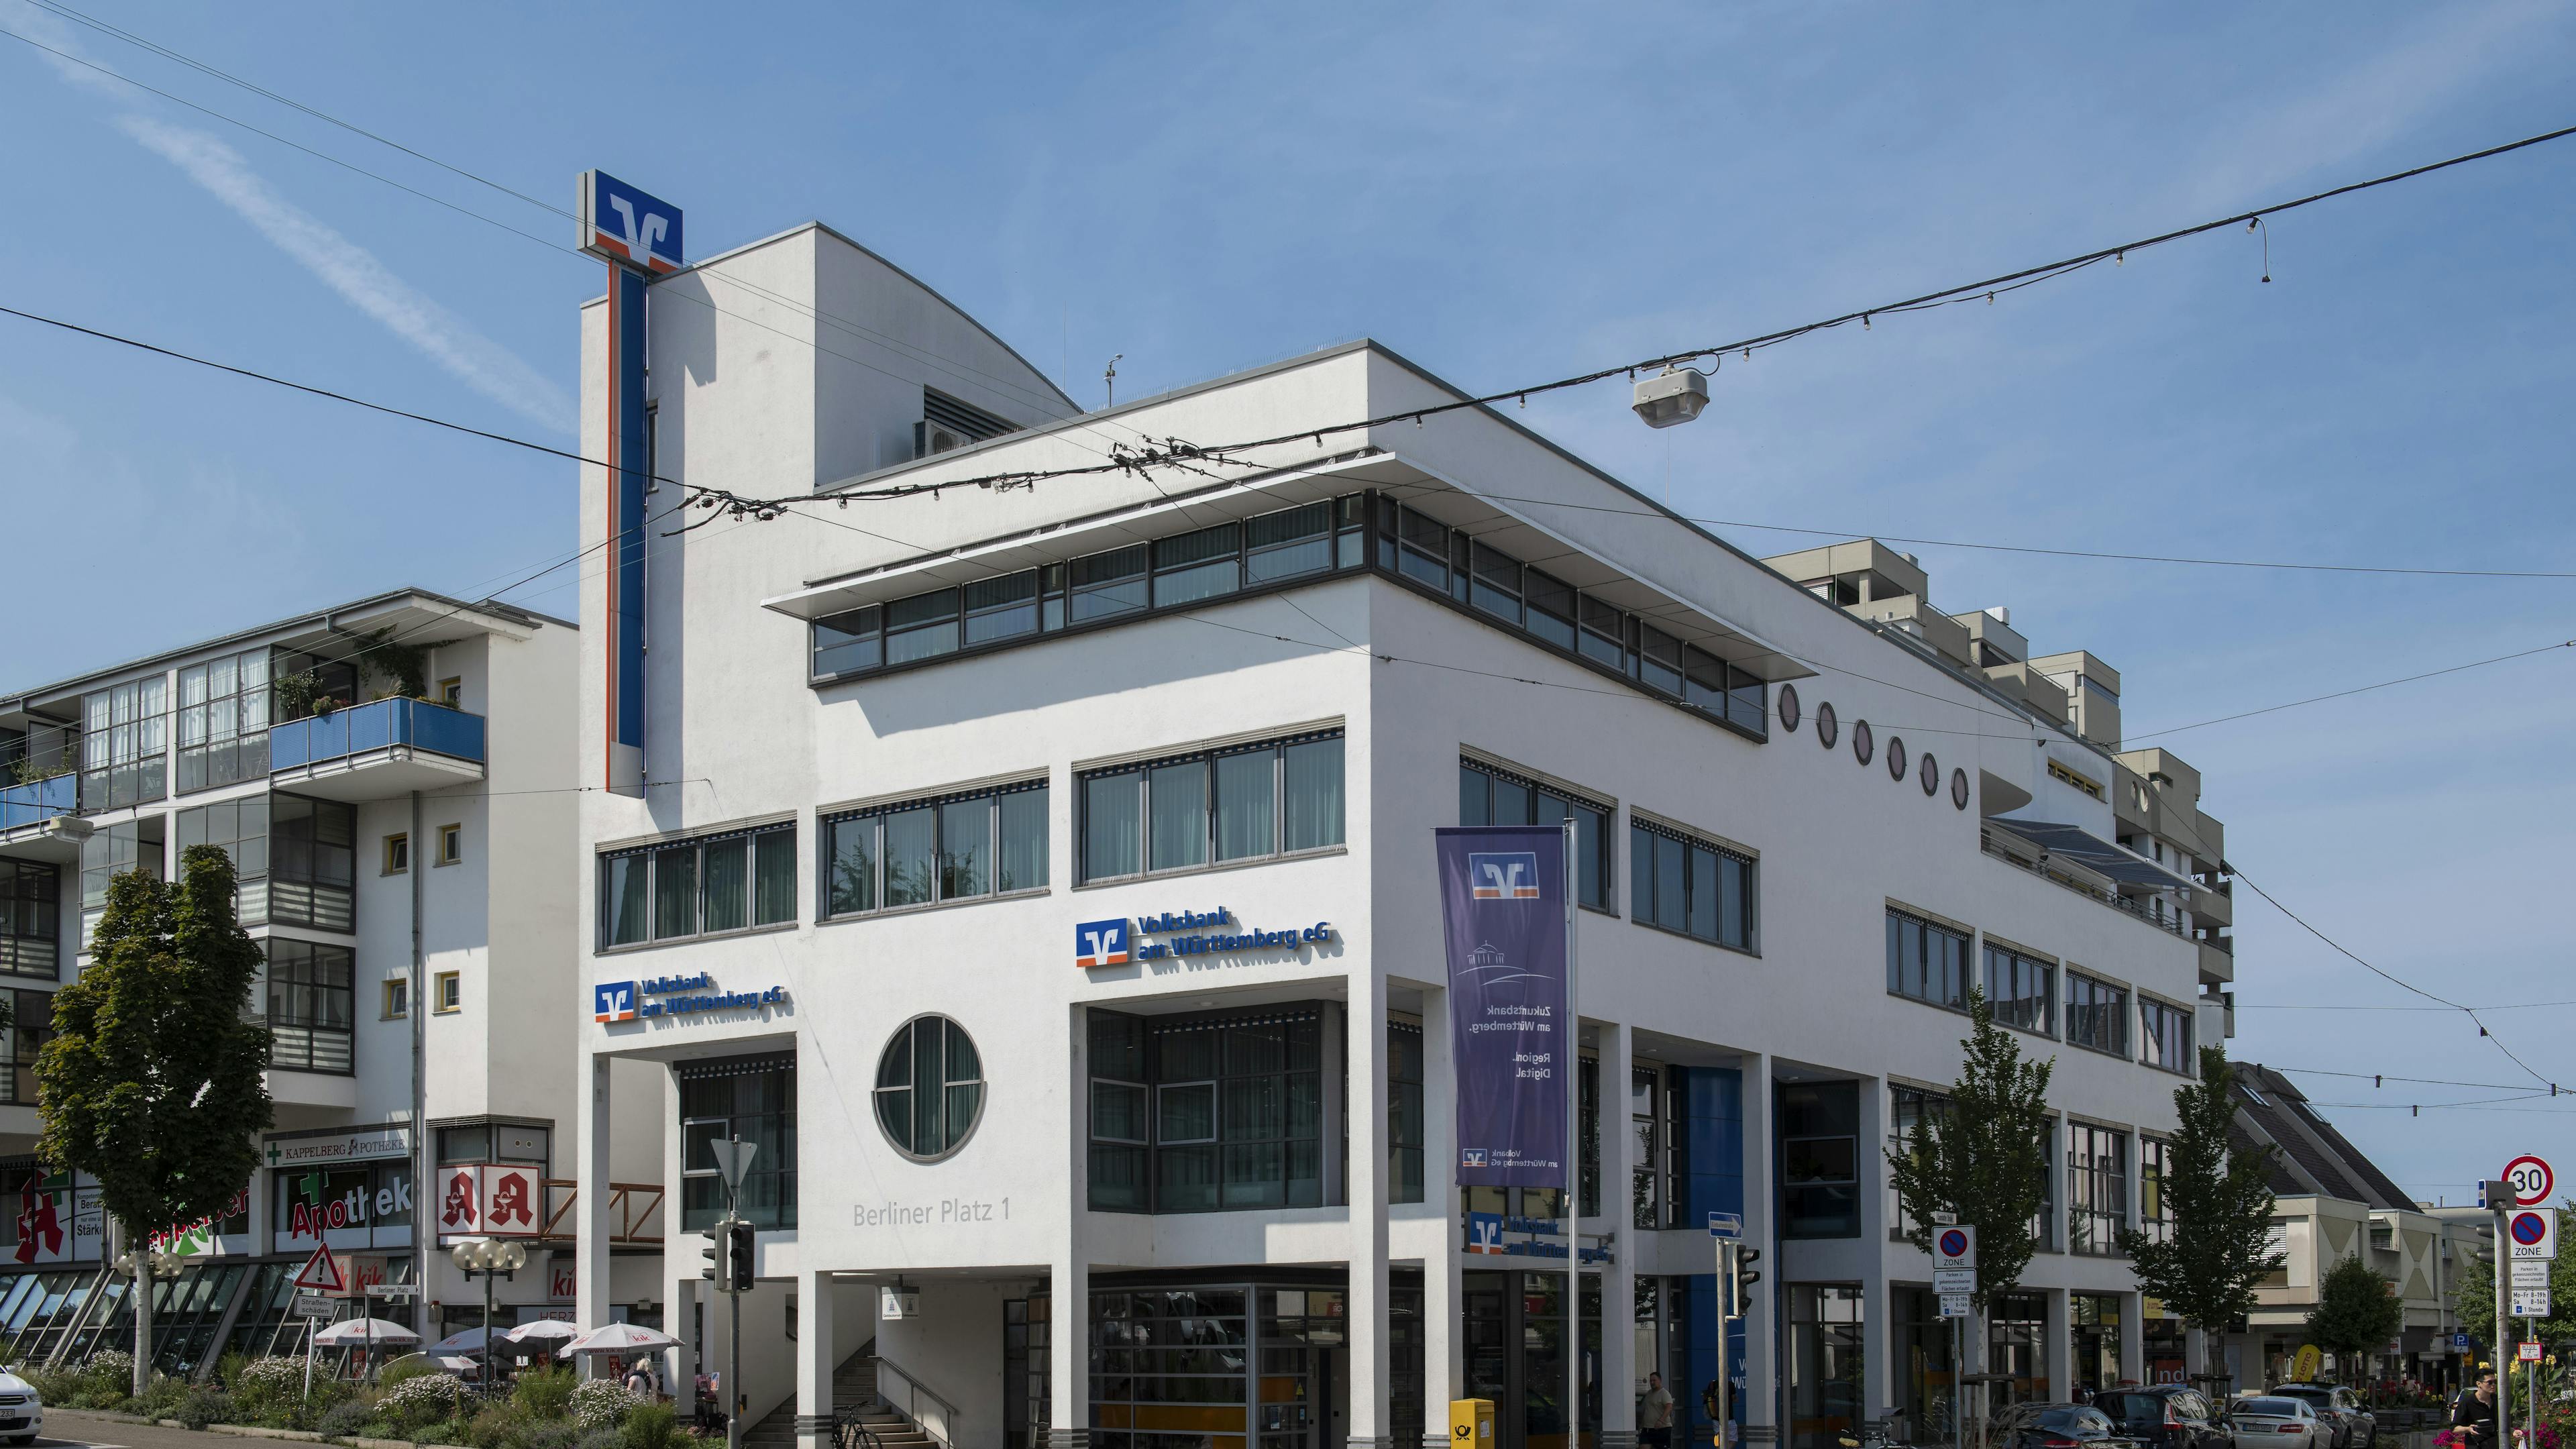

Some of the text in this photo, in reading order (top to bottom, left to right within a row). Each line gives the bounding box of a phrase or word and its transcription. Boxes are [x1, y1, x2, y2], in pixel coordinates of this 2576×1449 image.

[1138, 906, 1229, 934] Volksbank
[1138, 921, 1329, 960] am Württemberg eG
[641, 971, 709, 995] Volksbank
[641, 985, 782, 1017] am Württemberg eG
[286, 1144, 345, 1159] KAPPELBERG
[2512, 1169, 2542, 1192] 30
[854, 1197, 1009, 1226] Berliner Platz 1
[2516, 1247, 2542, 1256] ZONE
[633, 1332, 651, 1342] kik
[2299, 1352, 2312, 1376] LOTTO
